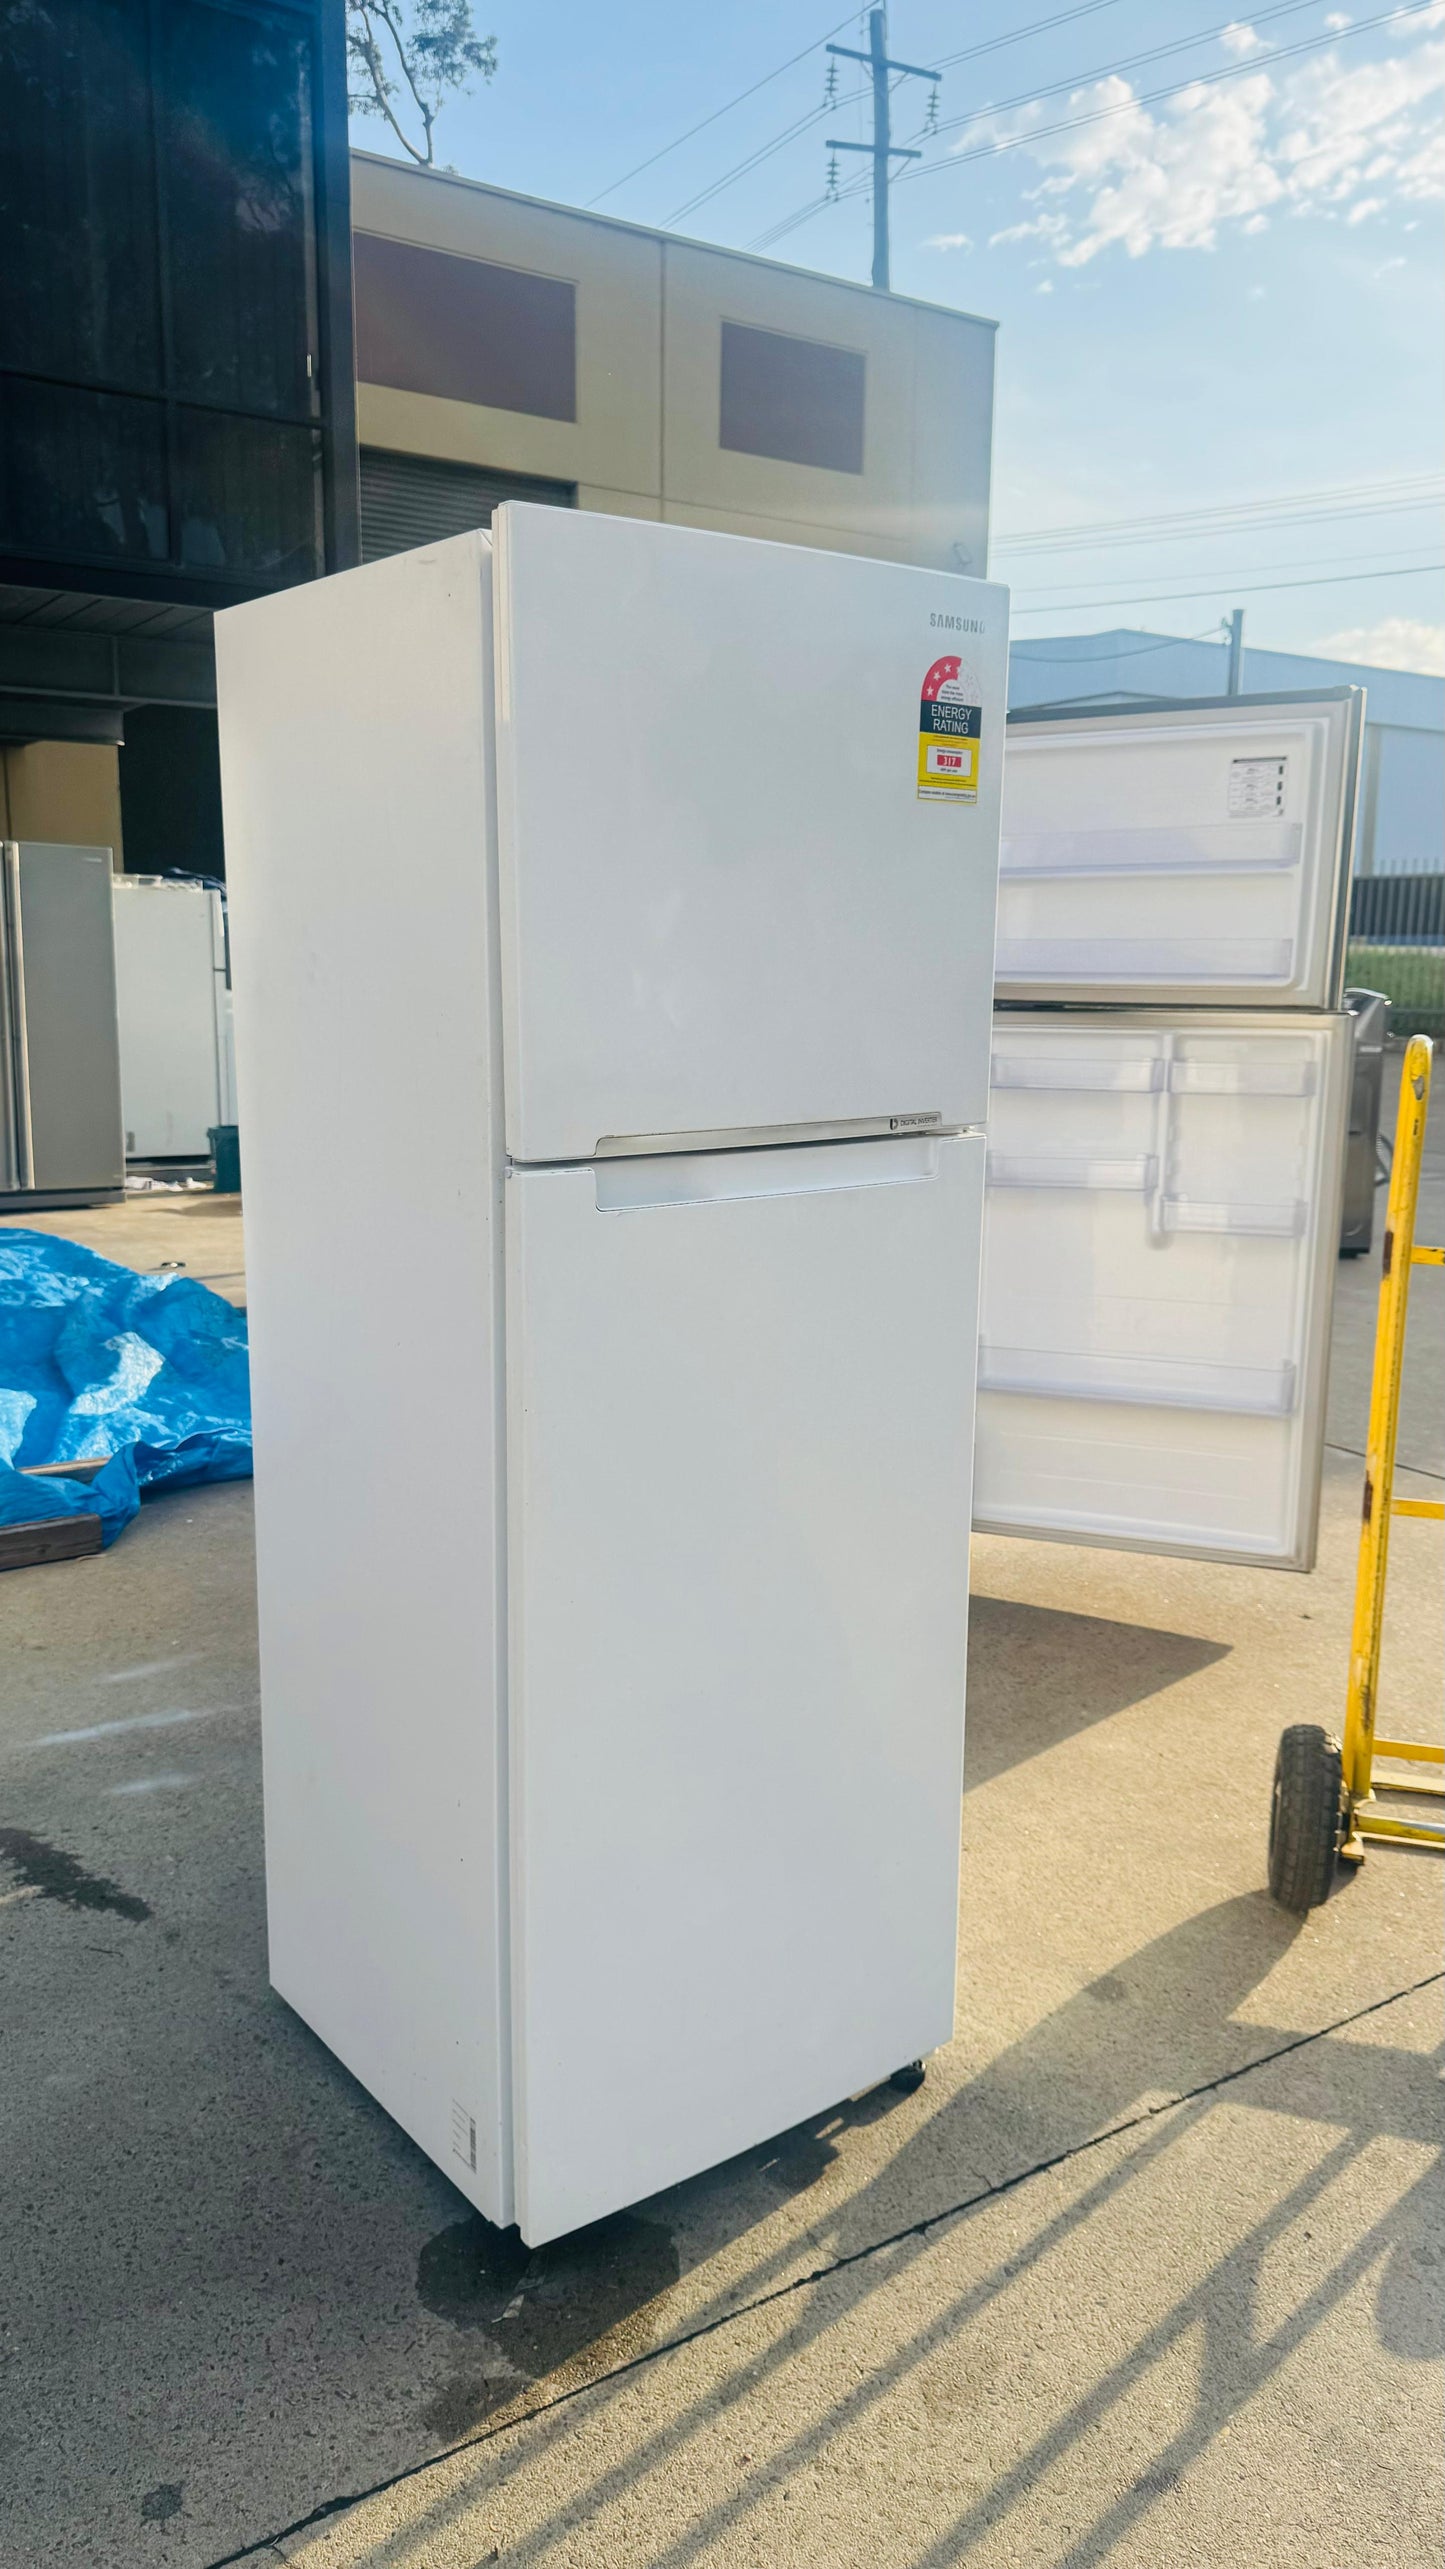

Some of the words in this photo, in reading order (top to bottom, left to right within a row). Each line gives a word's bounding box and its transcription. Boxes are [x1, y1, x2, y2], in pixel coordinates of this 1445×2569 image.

[931, 704, 973, 721] ENERGY
[933, 718, 969, 735] RATING
[943, 756, 957, 766] 317
